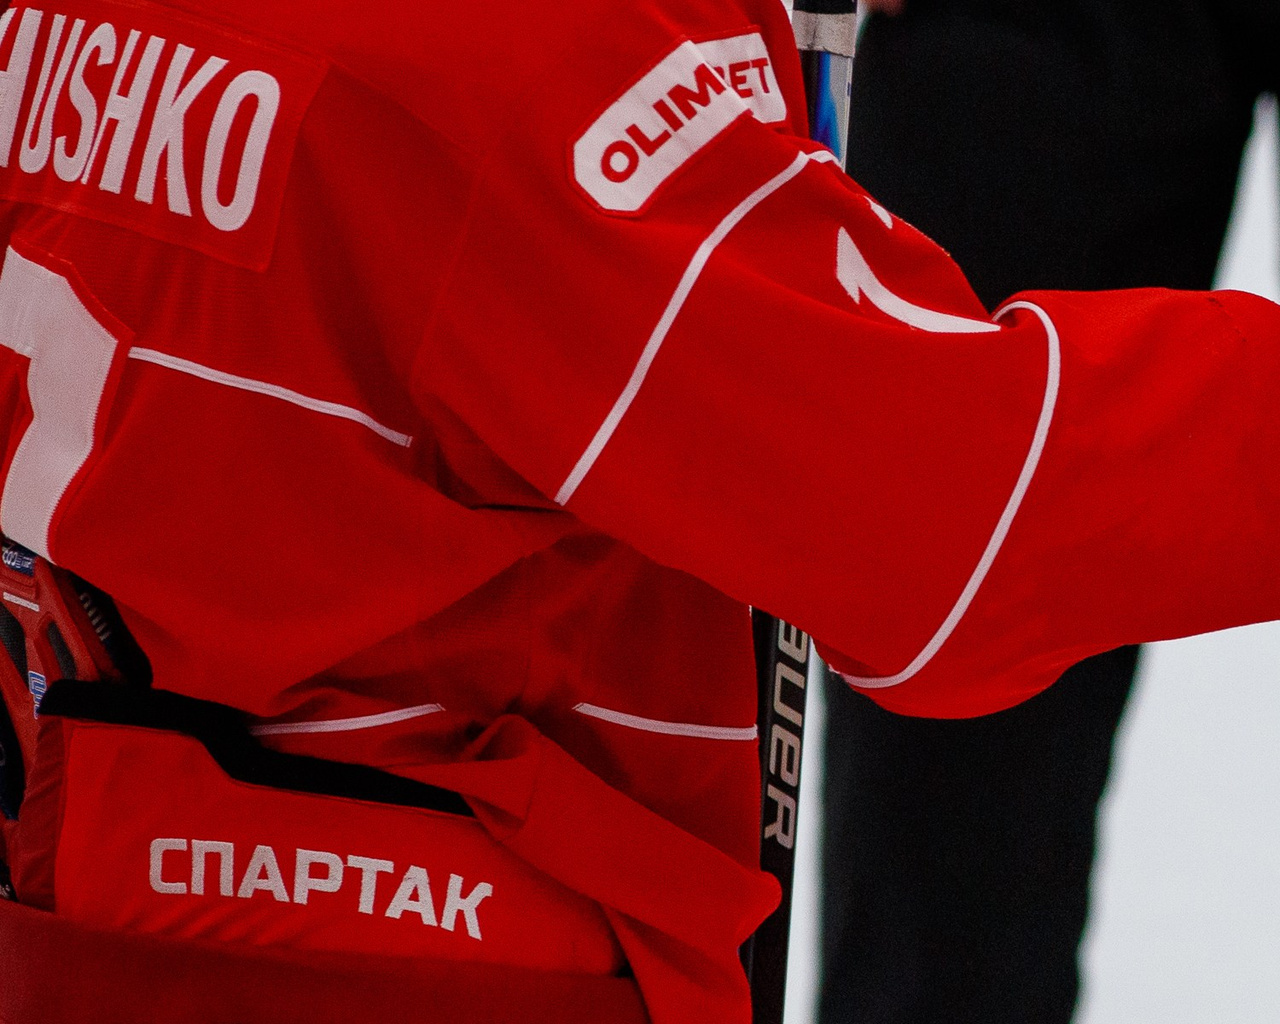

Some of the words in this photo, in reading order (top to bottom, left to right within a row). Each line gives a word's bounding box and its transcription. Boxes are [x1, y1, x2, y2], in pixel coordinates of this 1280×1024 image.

[601, 57, 770, 184] OLIMET
[764, 618, 810, 850] AUER
[149, 837, 494, 941] СПАРТАК
